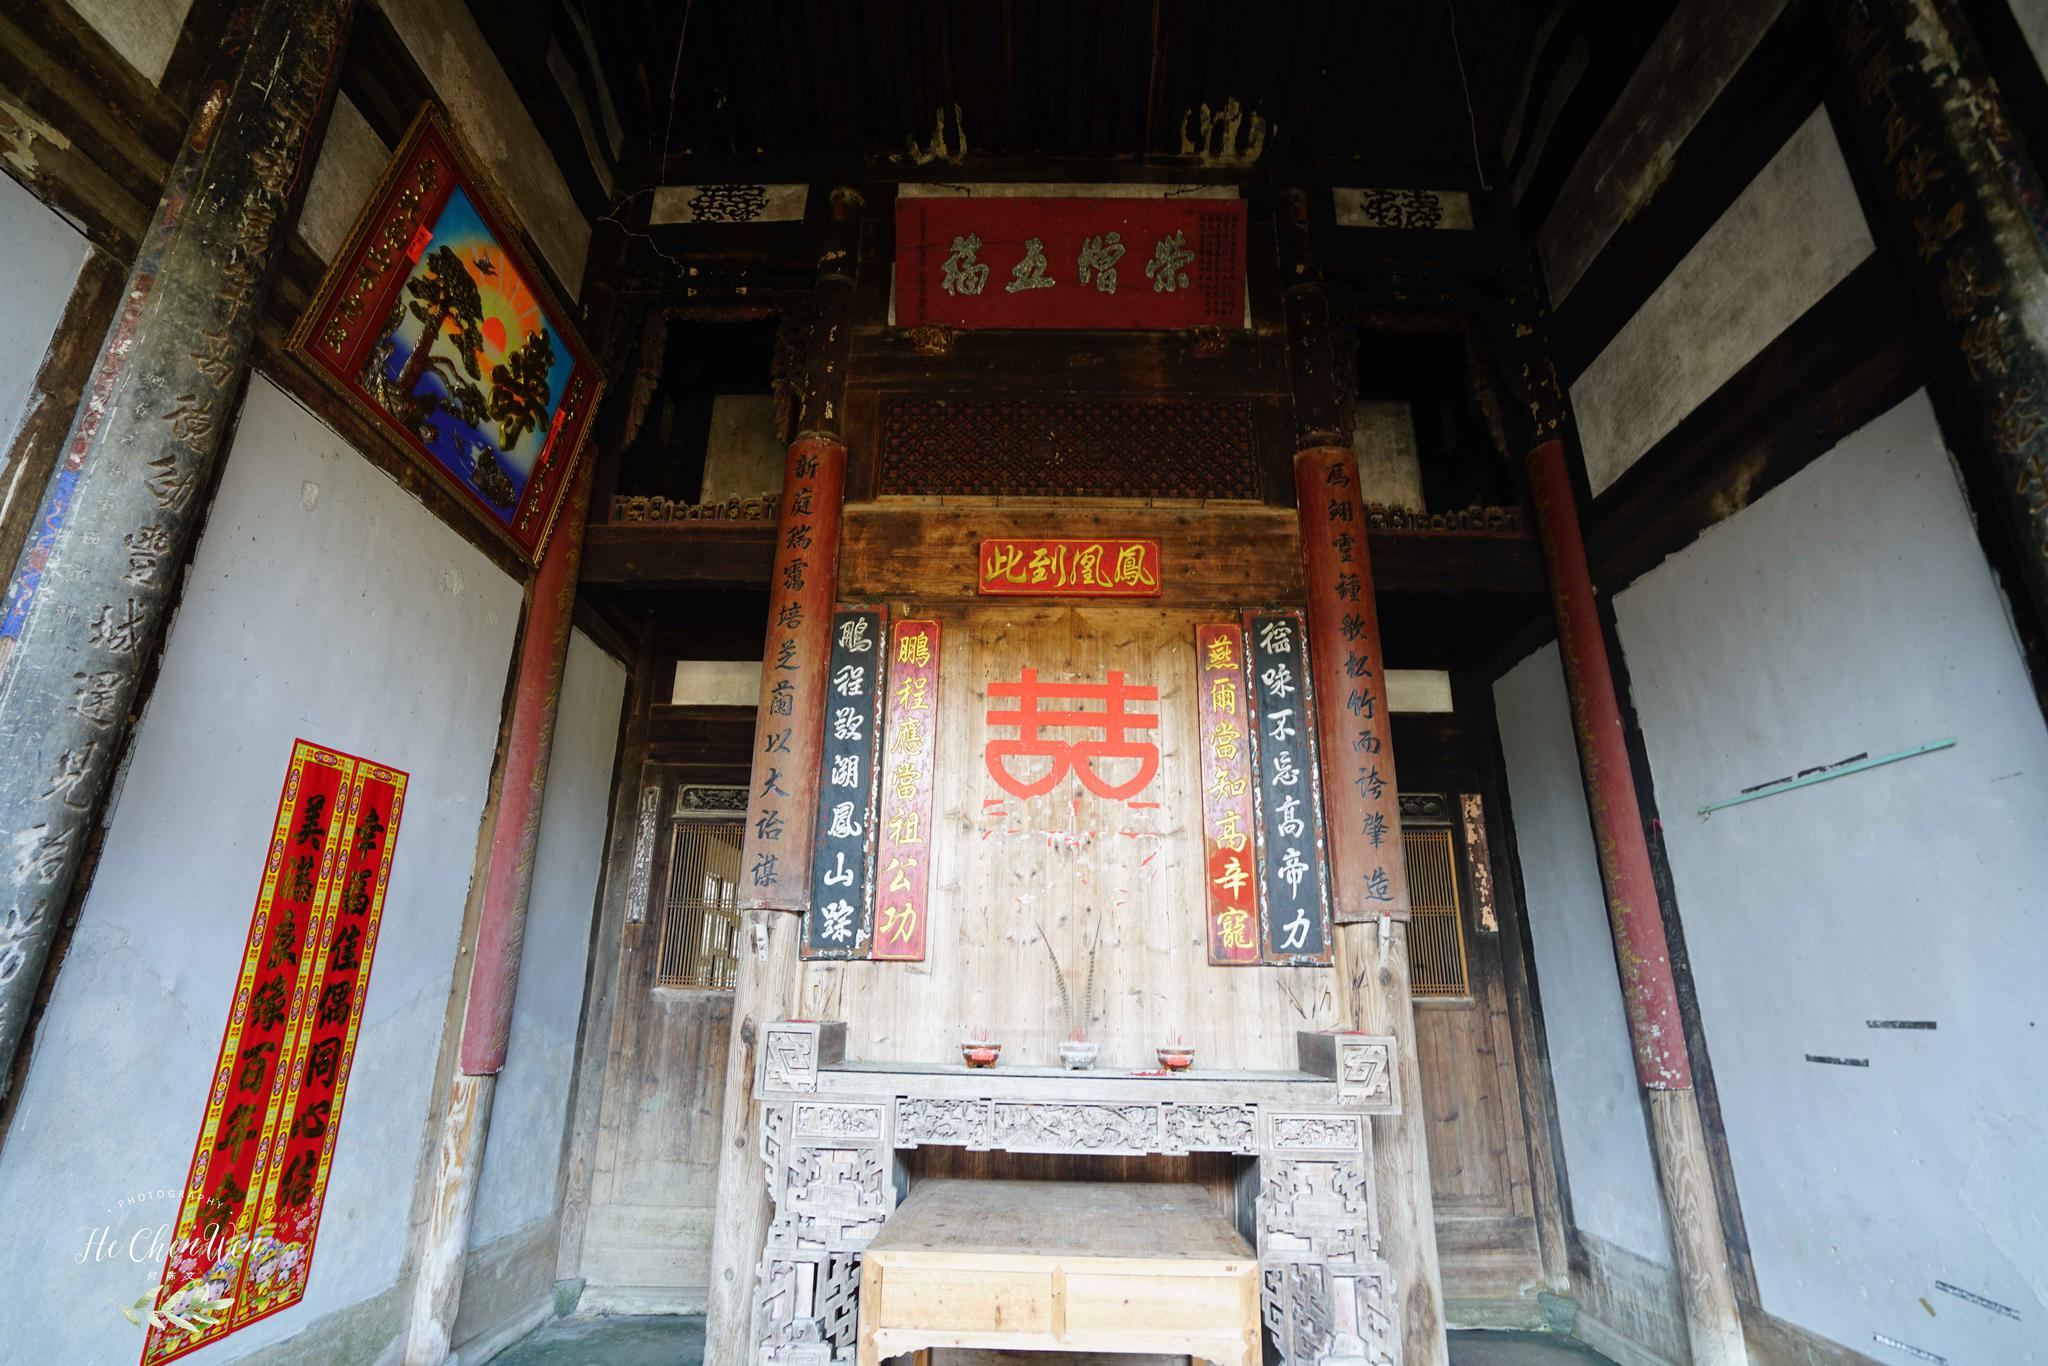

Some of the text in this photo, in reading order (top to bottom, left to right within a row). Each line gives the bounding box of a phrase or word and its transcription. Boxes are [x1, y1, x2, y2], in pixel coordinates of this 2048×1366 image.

[986, 544, 1156, 588] 鳳凰到此
[880, 631, 931, 944] 鵬程應當祖公功
[1205, 634, 1255, 949] 燕爾當知高辛寵
